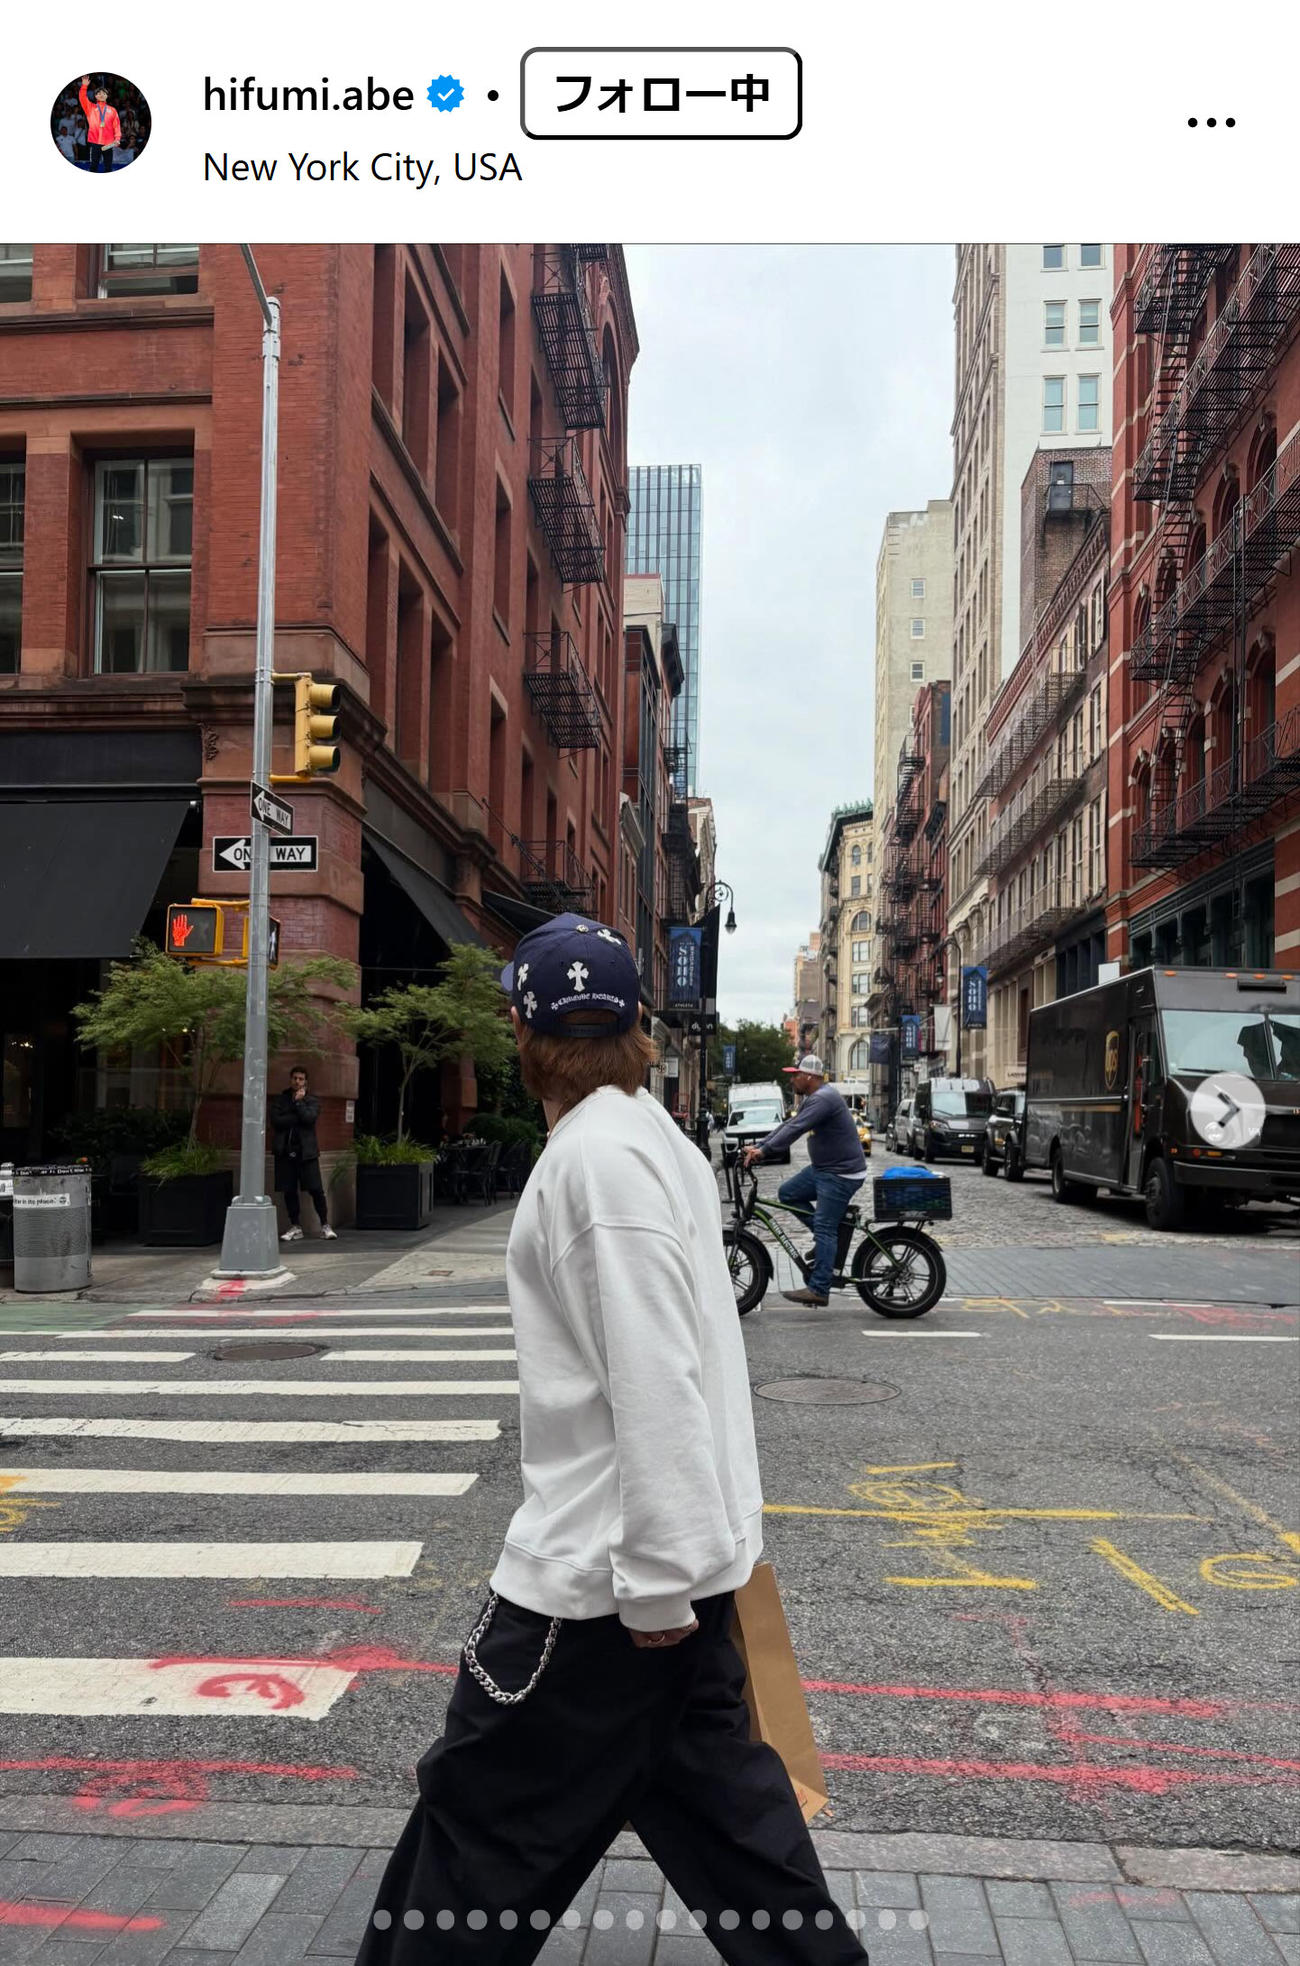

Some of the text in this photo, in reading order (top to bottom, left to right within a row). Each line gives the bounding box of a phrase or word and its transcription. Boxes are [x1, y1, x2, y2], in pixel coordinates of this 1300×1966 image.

[258, 797, 288, 826] ONE WAY
[234, 847, 306, 860] ON WAY
